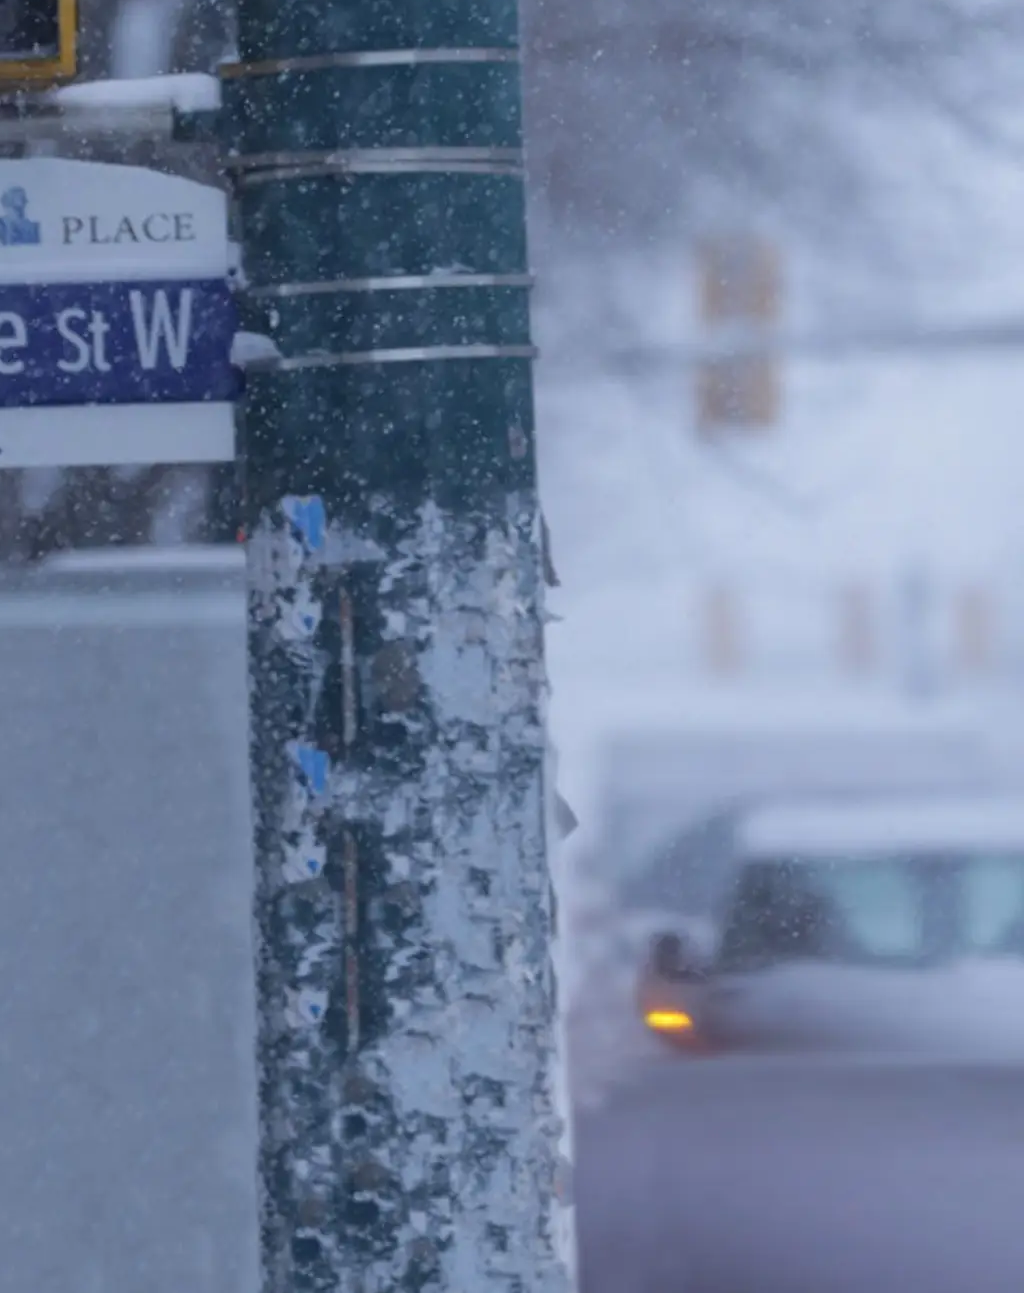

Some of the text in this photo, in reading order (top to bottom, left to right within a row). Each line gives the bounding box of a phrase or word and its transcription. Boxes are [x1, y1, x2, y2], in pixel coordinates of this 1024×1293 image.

[61, 213, 196, 245] PLACE
[55, 307, 111, 372] St
[129, 288, 193, 369] W
